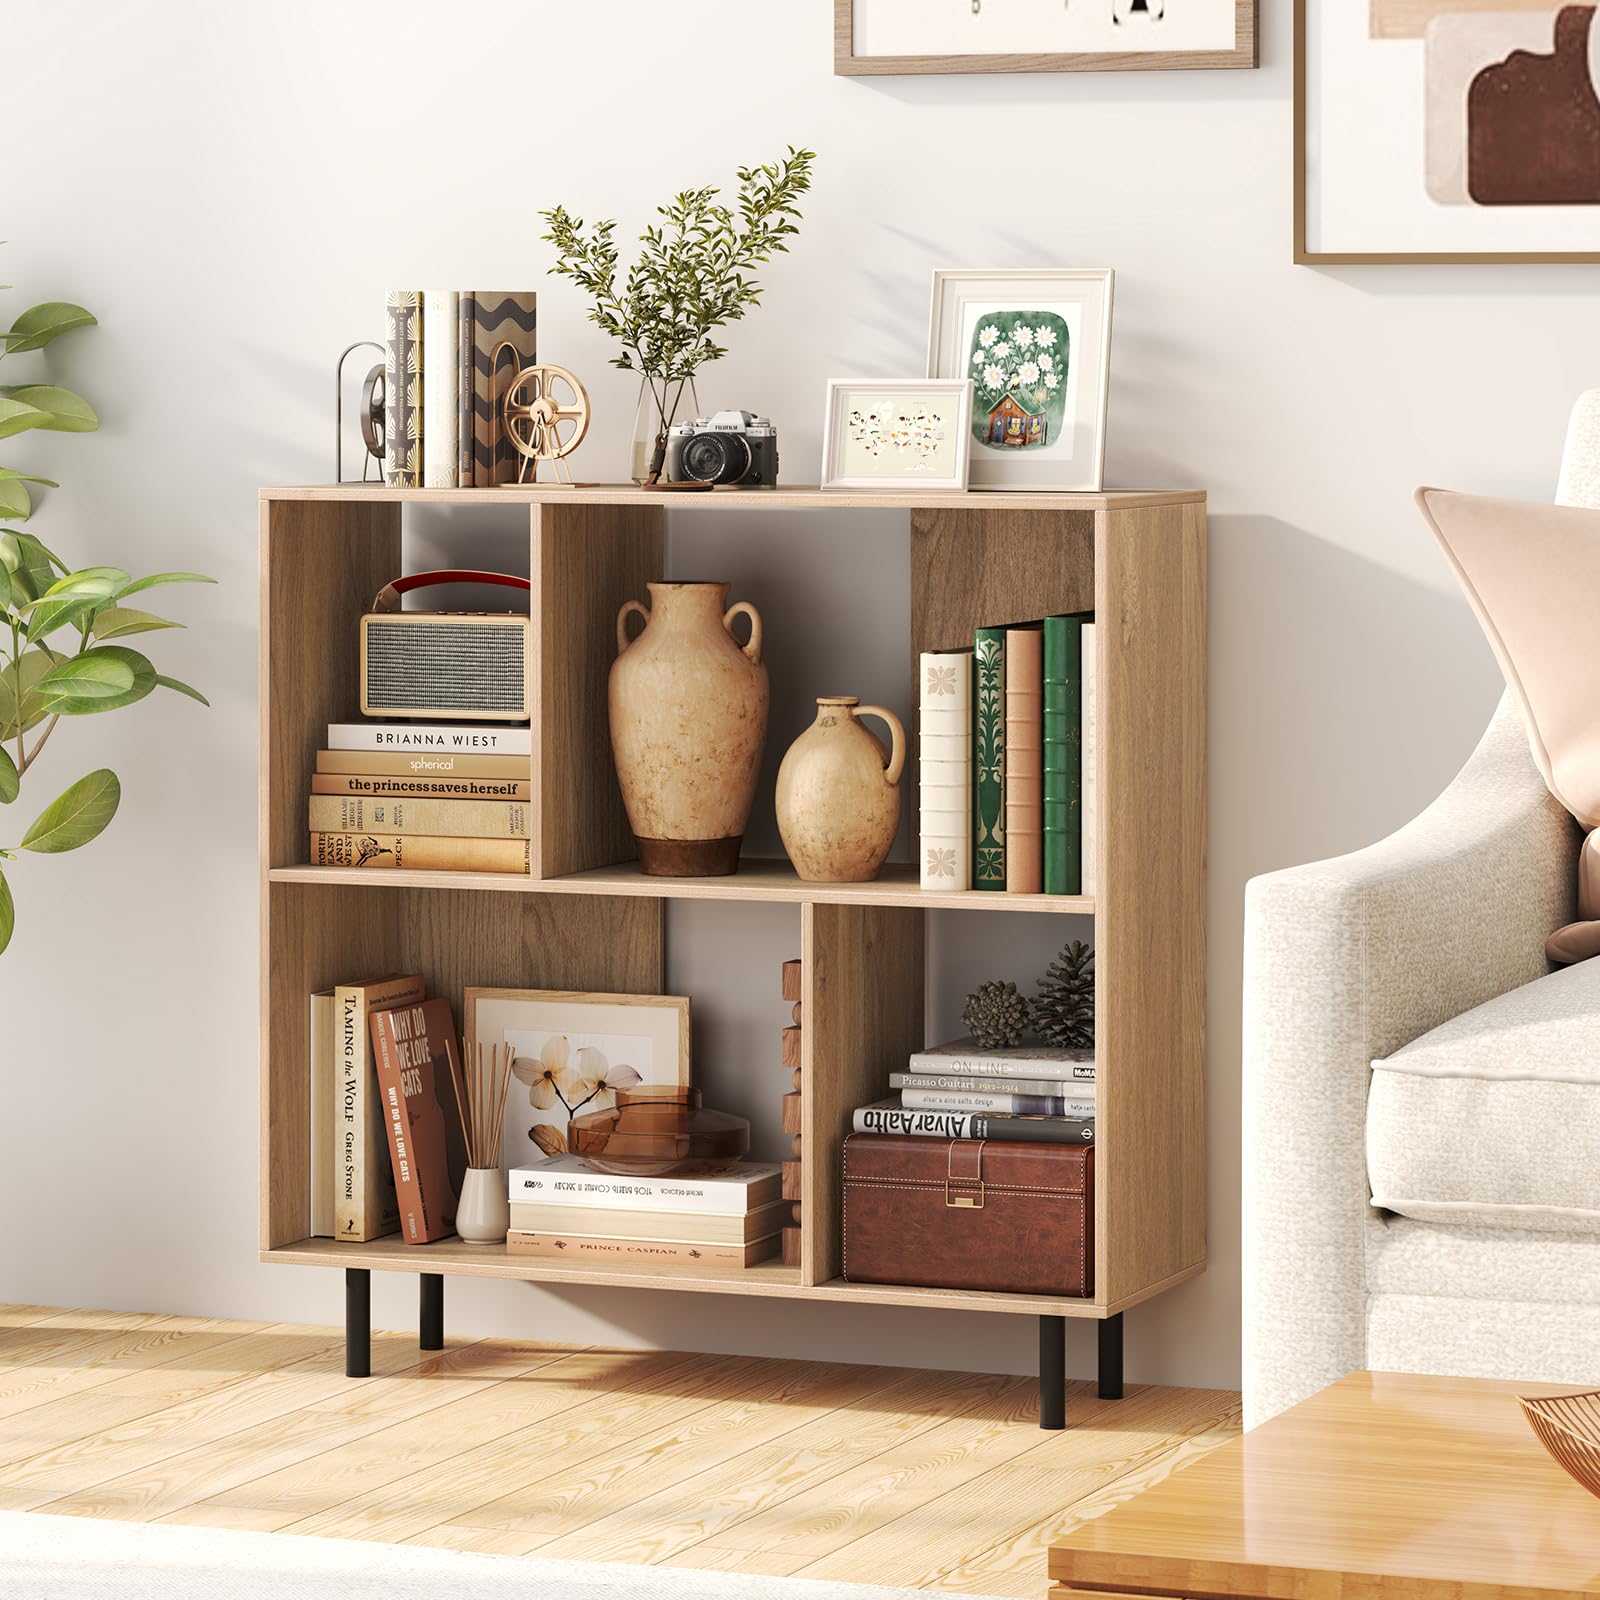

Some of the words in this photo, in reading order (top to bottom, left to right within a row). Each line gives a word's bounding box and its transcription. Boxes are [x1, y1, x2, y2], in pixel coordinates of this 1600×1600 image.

[376, 733, 445, 745] BRIANNA
[452, 735, 498, 747] WIEST
[410, 757, 454, 772] spherical
[469, 782, 519, 796] herself
[327, 835, 335, 865] EAST
[336, 838, 344, 864] AND
[344, 995, 357, 1057] TAMING
[389, 1009, 412, 1043] WHY
[411, 1007, 427, 1037] DO
[395, 1041, 412, 1070] WE
[411, 1037, 432, 1066] LOVE
[344, 1060, 354, 1077] the
[951, 1060, 972, 1073] ON
[977, 1062, 1009, 1076] LINE
[400, 1068, 423, 1099] CATS
[902, 1075, 936, 1088] Picasso
[938, 1077, 975, 1089] Guitars
[344, 1079, 357, 1122] WOLF
[388, 1086, 398, 1107] WHY
[974, 1098, 993, 1107] design
[391, 1108, 401, 1121] DO
[393, 1121, 403, 1136] WE
[345, 1131, 355, 1163] GREG
[395, 1137, 407, 1159] LOVE
[399, 1159, 410, 1182] CATS
[345, 1165, 355, 1200] STONE
[579, 1243, 622, 1252] PRINCE
[626, 1246, 678, 1256] CASPIAN
